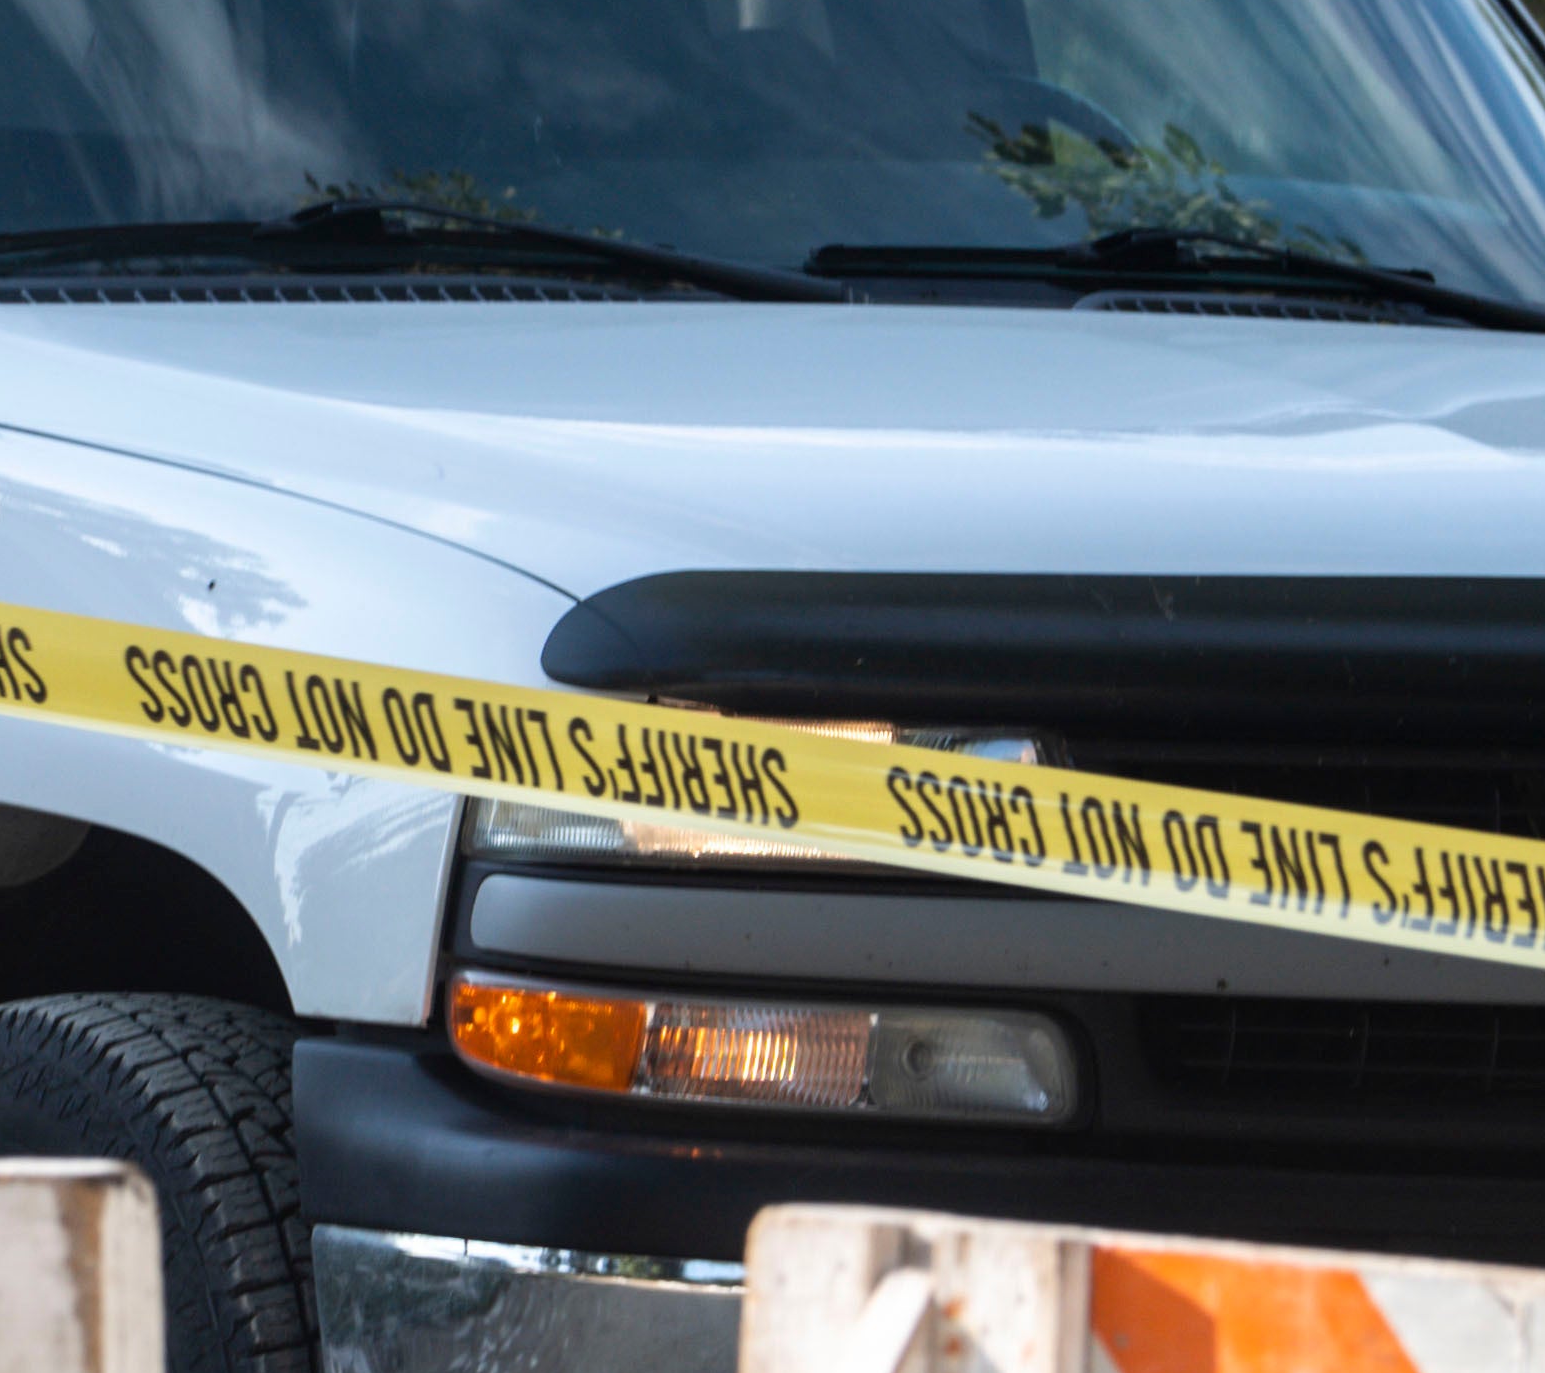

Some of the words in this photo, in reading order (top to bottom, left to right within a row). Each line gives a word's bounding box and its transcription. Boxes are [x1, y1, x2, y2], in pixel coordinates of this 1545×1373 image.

[124, 643, 278, 742] CROSS
[284, 669, 378, 760] NOT
[381, 686, 452, 771] DO
[453, 696, 565, 788] LINE
[567, 715, 800, 829] SHERIFF'S
[886, 765, 1046, 867] CROSS
[1059, 791, 1151, 884] NOT
[1161, 808, 1231, 898] DO
[1239, 819, 1351, 917] LINE
